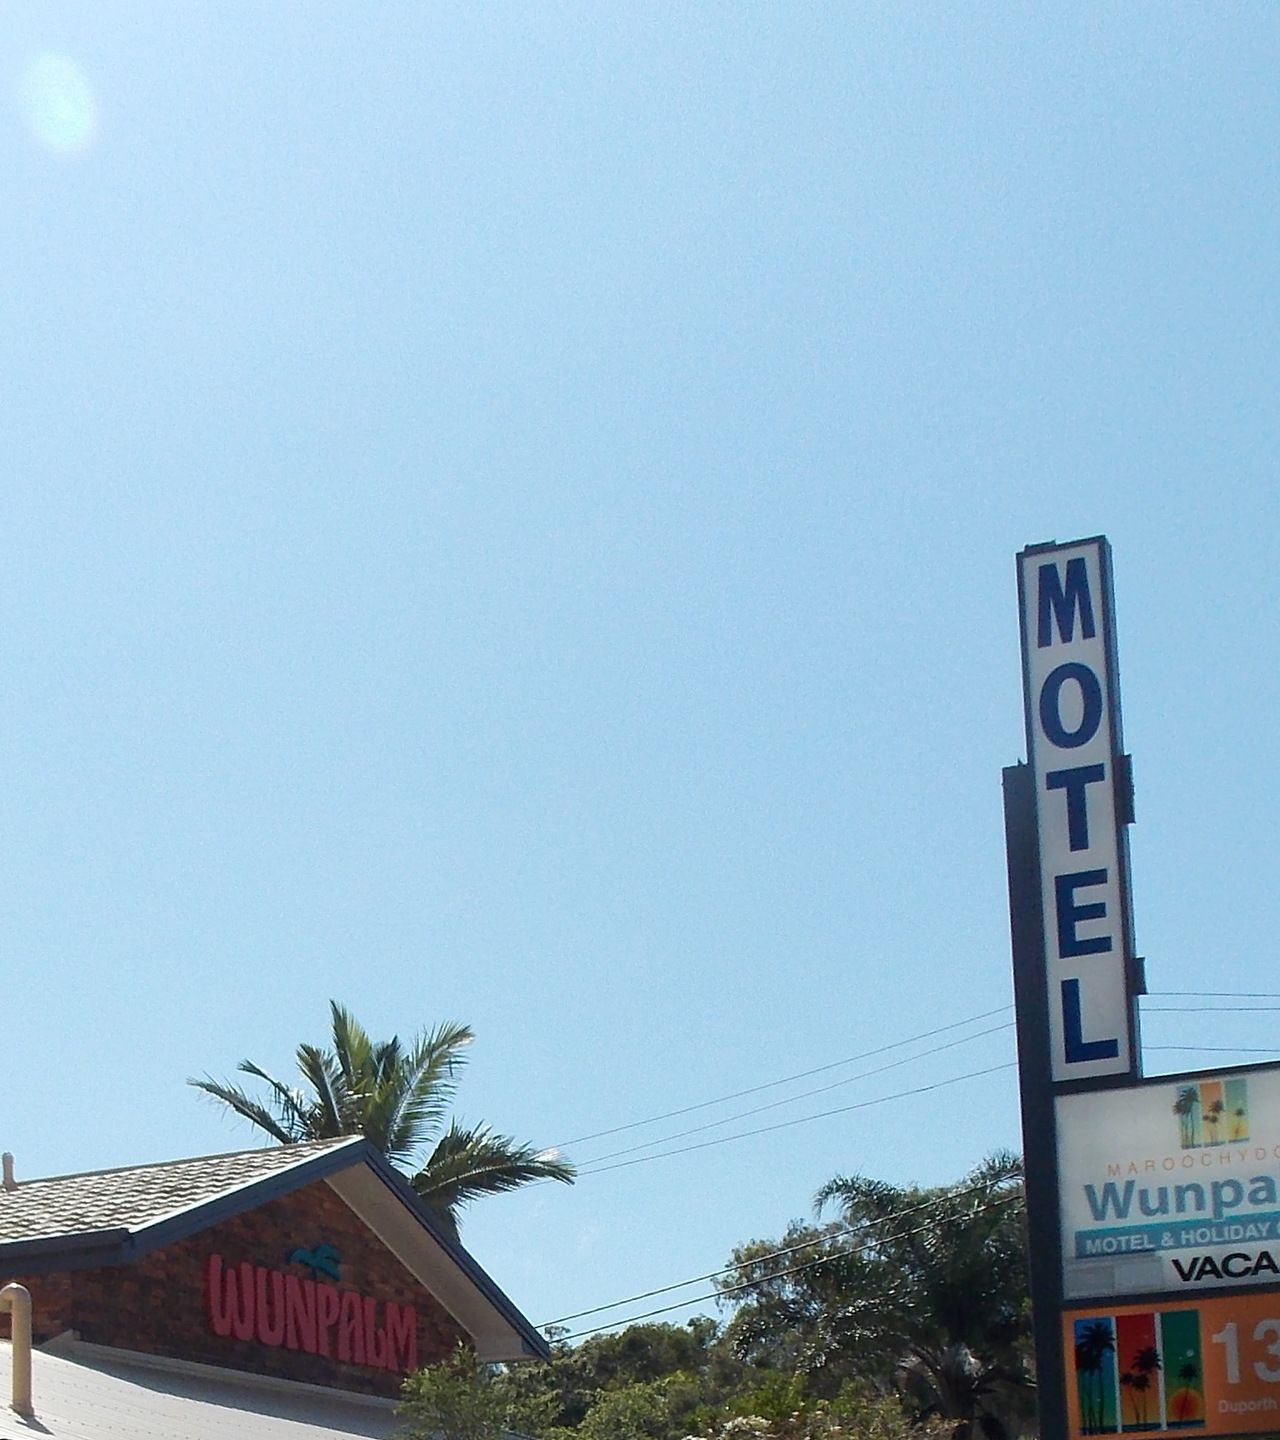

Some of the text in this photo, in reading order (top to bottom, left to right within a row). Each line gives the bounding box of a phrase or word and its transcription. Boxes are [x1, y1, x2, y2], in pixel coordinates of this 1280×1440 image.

[1037, 557, 1119, 1064] MOTEL
[1086, 1232, 1156, 1255] MOTEL
[1160, 1231, 1175, 1248] &
[1181, 1222, 1271, 1245] HOLIDAY
[207, 1253, 417, 1372] WUNPALM
[1218, 1397, 1277, 1415] Duporth
